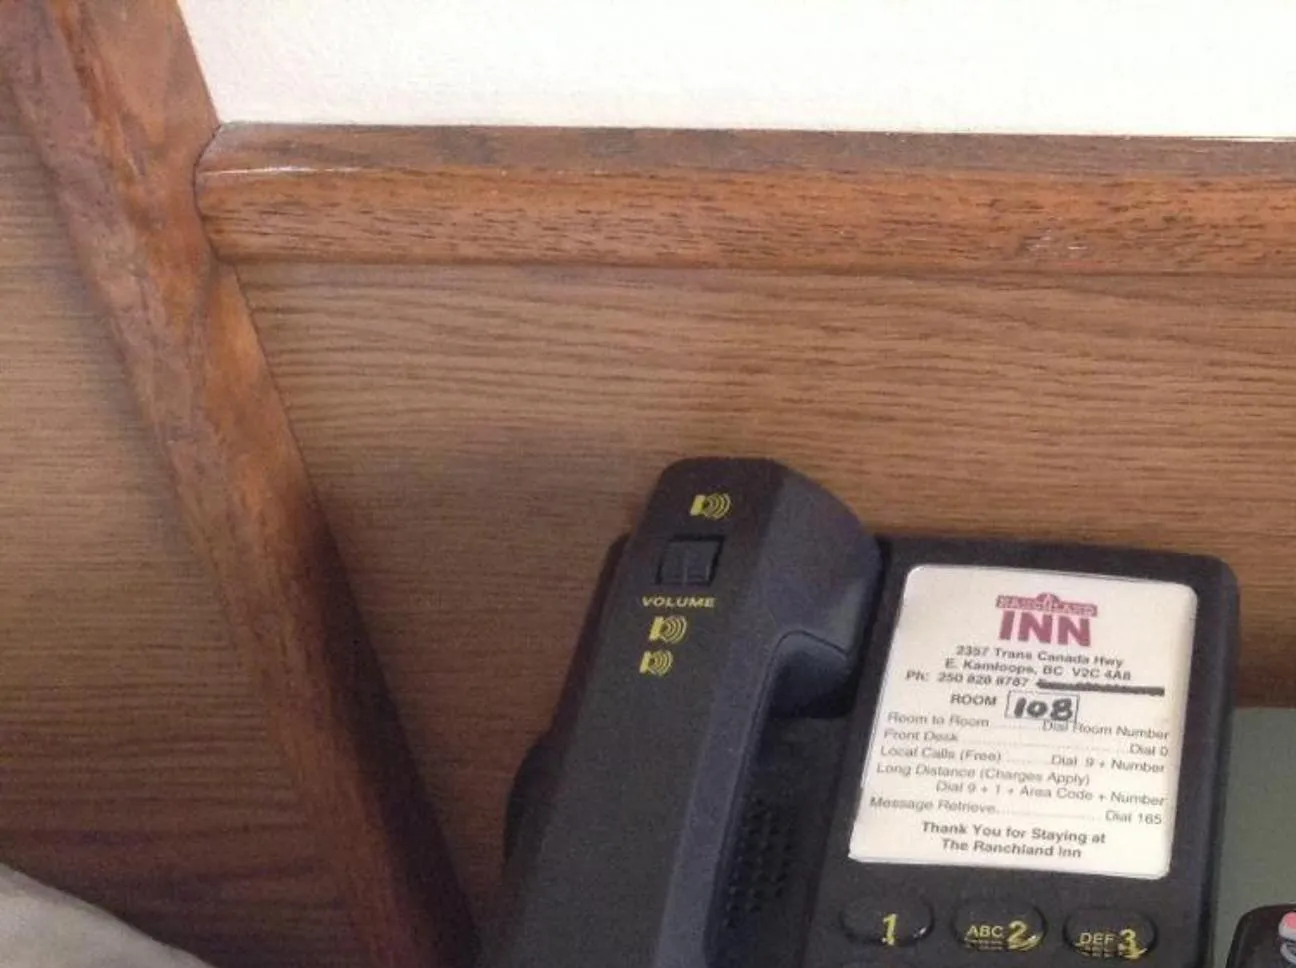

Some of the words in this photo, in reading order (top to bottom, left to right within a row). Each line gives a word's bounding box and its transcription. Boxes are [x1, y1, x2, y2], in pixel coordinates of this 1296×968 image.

[642, 596, 715, 608] VOLUME
[999, 611, 1091, 646] INN
[963, 660, 1037, 676] Kamloops,
[1043, 665, 1064, 677] BC
[1072, 667, 1101, 679] V2C
[994, 649, 1033, 661] Trans
[1037, 651, 1090, 665] Canada
[1094, 655, 1125, 668] Hwy
[905, 670, 931, 683] Ph:
[937, 672, 964, 684] 250
[950, 693, 998, 707] ROOM
[1013, 696, 1074, 722] 108
[887, 711, 928, 725] Room
[932, 713, 945, 726] to
[949, 714, 990, 728] Room
[1042, 719, 1069, 733] Dial
[1073, 722, 1112, 737] Room
[1116, 725, 1170, 741] Number
[883, 727, 920, 741] Front
[923, 730, 959, 743] Desk
[1129, 743, 1156, 757] Dial
[880, 745, 920, 759] Local
[921, 748, 956, 760] Calls
[960, 749, 1003, 762] (Free)
[1051, 754, 1078, 767] Dial
[1085, 756, 1096, 769] 9
[1111, 759, 1166, 774] Number
[876, 763, 912, 777] Long
[915, 764, 976, 779] Distance
[979, 768, 1043, 784] (Charges
[1047, 771, 1091, 786] Apply)
[936, 780, 964, 793] Dial
[967, 782, 978, 793] 9
[1019, 785, 1052, 798] Area
[1056, 787, 1094, 801] Code
[1110, 791, 1167, 806] Number
[870, 797, 934, 812] Message
[938, 799, 997, 813] Retrieve
[1105, 810, 1133, 823] Dial
[1138, 812, 1163, 825] 165
[922, 820, 968, 834] Thank
[972, 823, 1002, 838] You
[1006, 826, 1029, 840] for
[1031, 828, 1088, 845] Staying
[1091, 833, 1108, 844] at
[941, 837, 969, 851] The
[973, 840, 1054, 857] Ranchland
[1058, 846, 1083, 858] Inn
[880, 913, 897, 944] 1
[966, 924, 1004, 939] ABC
[1007, 920, 1033, 947] 2
[1079, 931, 1115, 947] DEF
